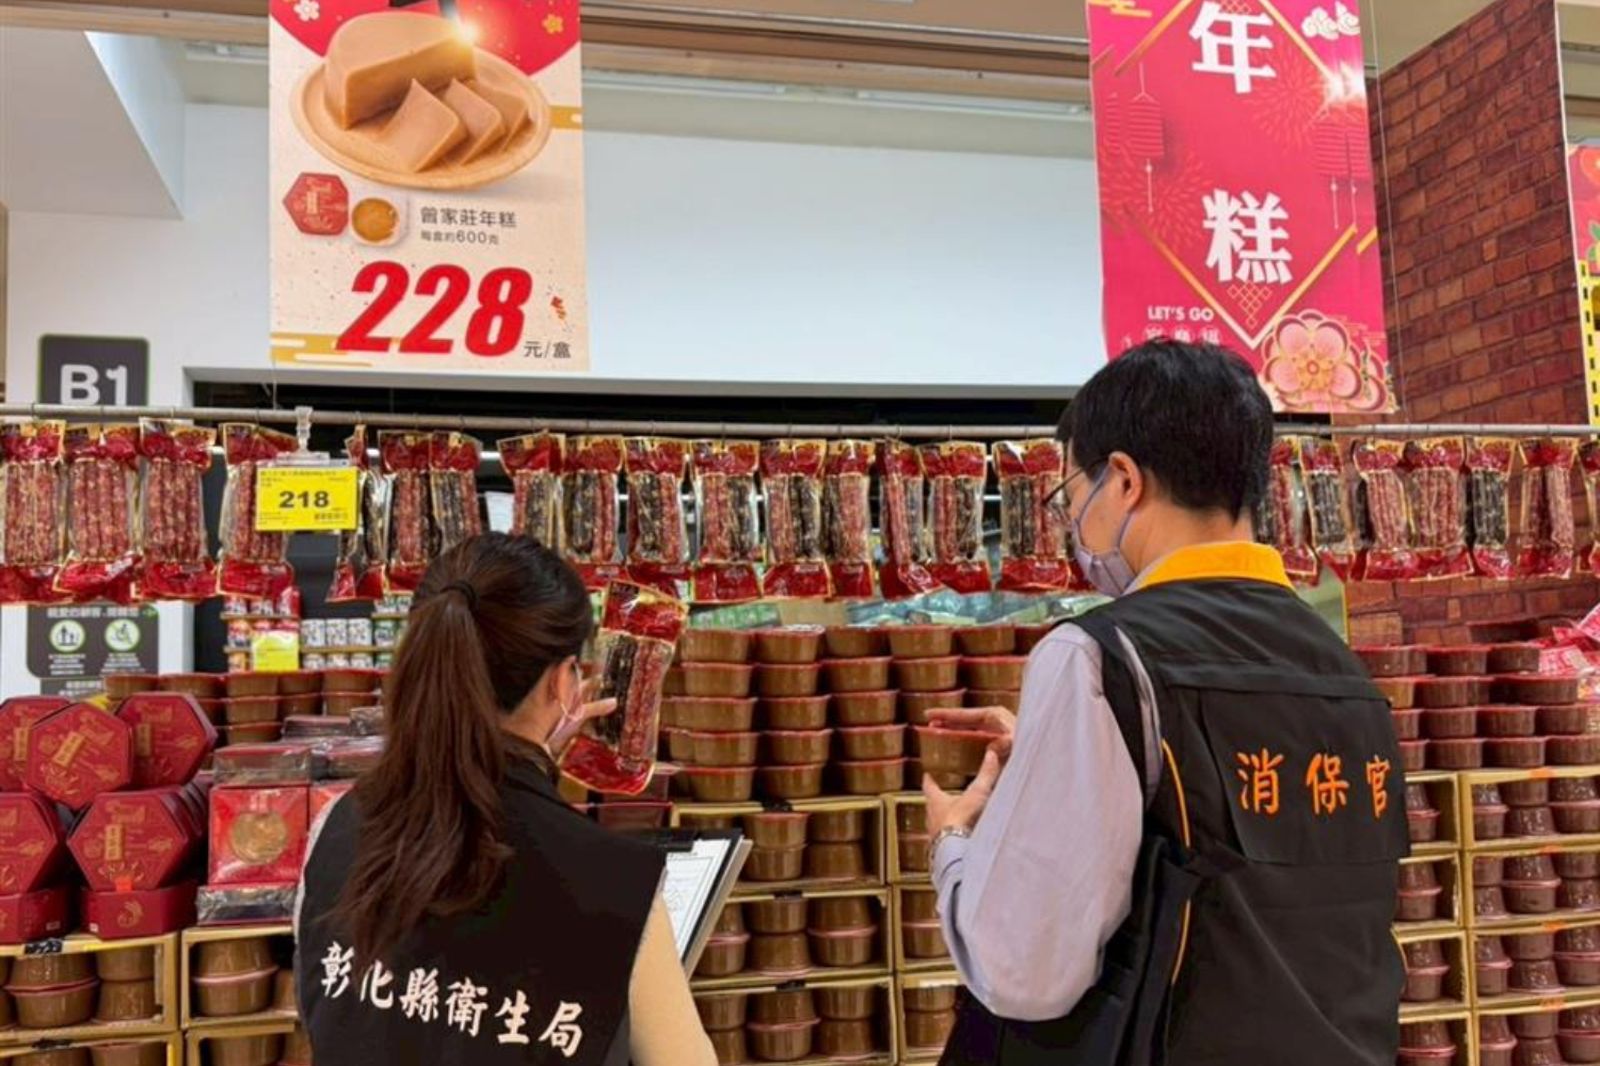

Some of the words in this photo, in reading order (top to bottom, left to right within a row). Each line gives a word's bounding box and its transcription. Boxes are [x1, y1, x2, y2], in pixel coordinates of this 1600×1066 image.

[1189, 1, 1293, 284] 年糕
[334, 260, 532, 357] 228
[524, 341, 571, 358] 元/盒
[1147, 305, 1185, 321] LET'S
[1189, 306, 1214, 322] GO
[61, 364, 127, 406] B1
[279, 490, 329, 508] 218
[1237, 747, 1391, 819] 消保官
[321, 941, 585, 1058] 彰化縣衛生局
